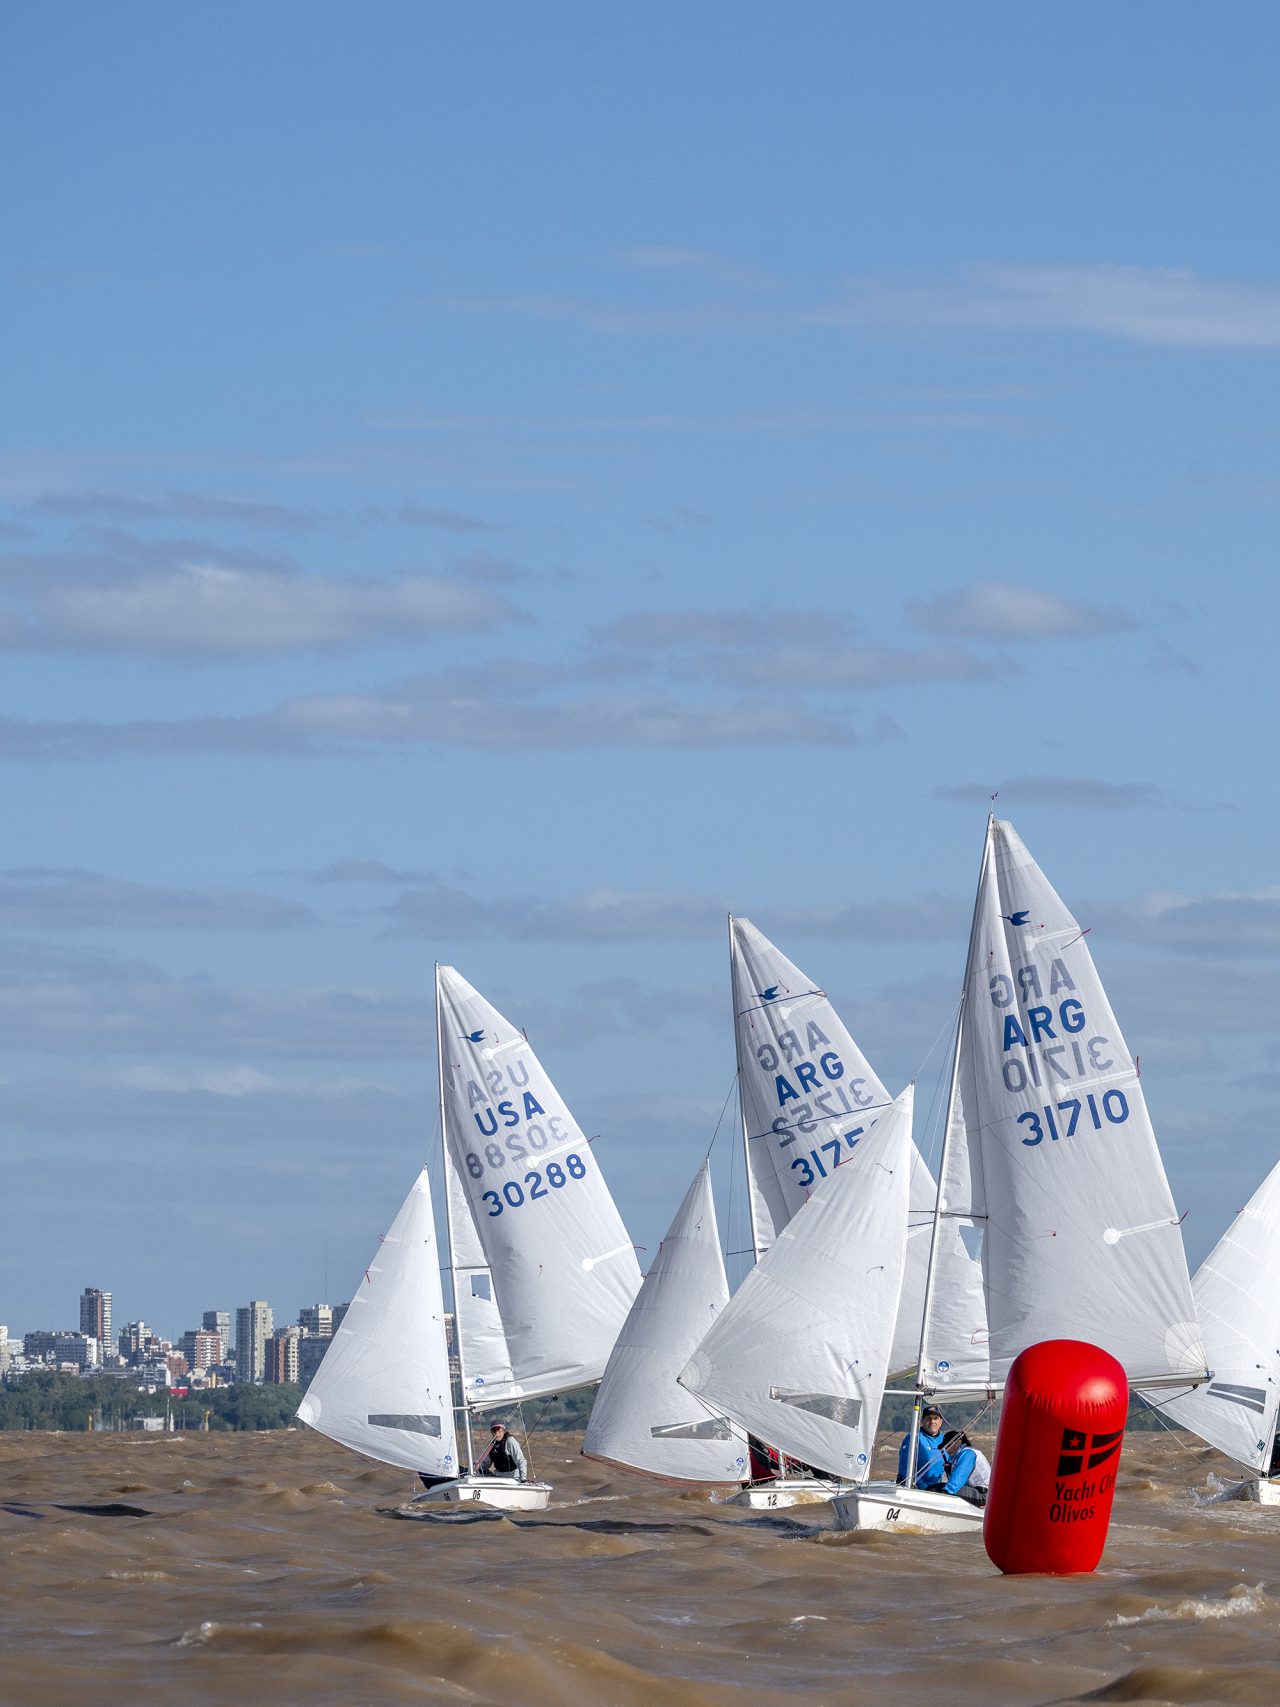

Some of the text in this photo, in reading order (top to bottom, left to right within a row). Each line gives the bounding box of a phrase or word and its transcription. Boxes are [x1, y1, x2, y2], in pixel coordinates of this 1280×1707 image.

[1003, 998, 1086, 1052] ARG
[774, 1052, 845, 1107] ARG
[473, 1091, 545, 1136] USA
[1016, 1089, 1130, 1146] 31710
[791, 1118, 878, 1187] 3175
[482, 1154, 586, 1217] 30288
[472, 1489, 482, 1500] 06
[767, 1493, 778, 1507] 12
[1049, 1504, 1095, 1523] Olivos
[1055, 1481, 1096, 1501] Yacht
[886, 1507, 901, 1521] 04
